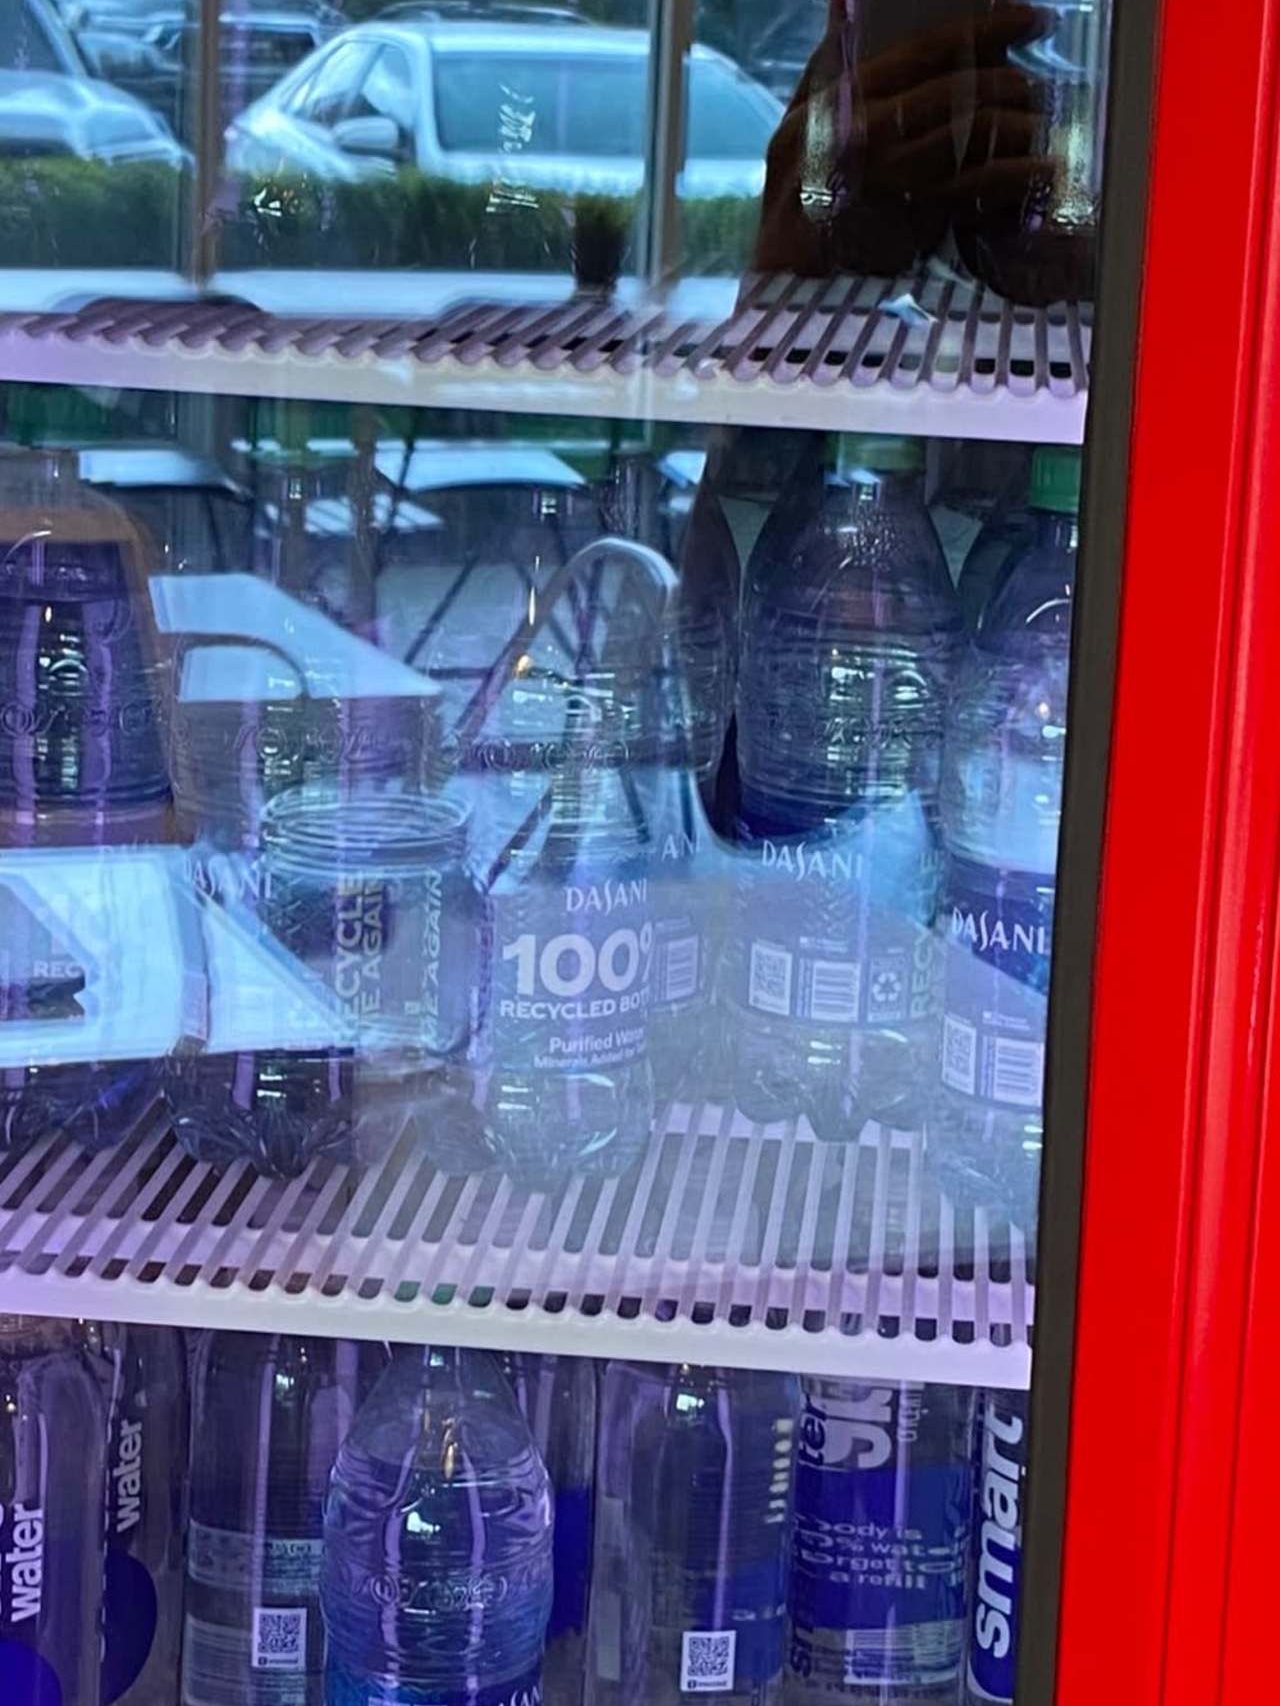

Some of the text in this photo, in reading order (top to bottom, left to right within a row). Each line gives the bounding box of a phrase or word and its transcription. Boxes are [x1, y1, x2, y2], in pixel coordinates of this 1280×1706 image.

[761, 839, 864, 882] DASANI
[564, 877, 647, 916] DASANI
[334, 870, 362, 1037] ECYCLE
[951, 905, 1046, 955] DASANI
[500, 997, 616, 1019] RECYCLED
[549, 1031, 613, 1054] Purified
[112, 1418, 143, 1534] water
[975, 1402, 1023, 1659] smart
[6, 1503, 45, 1623] water
